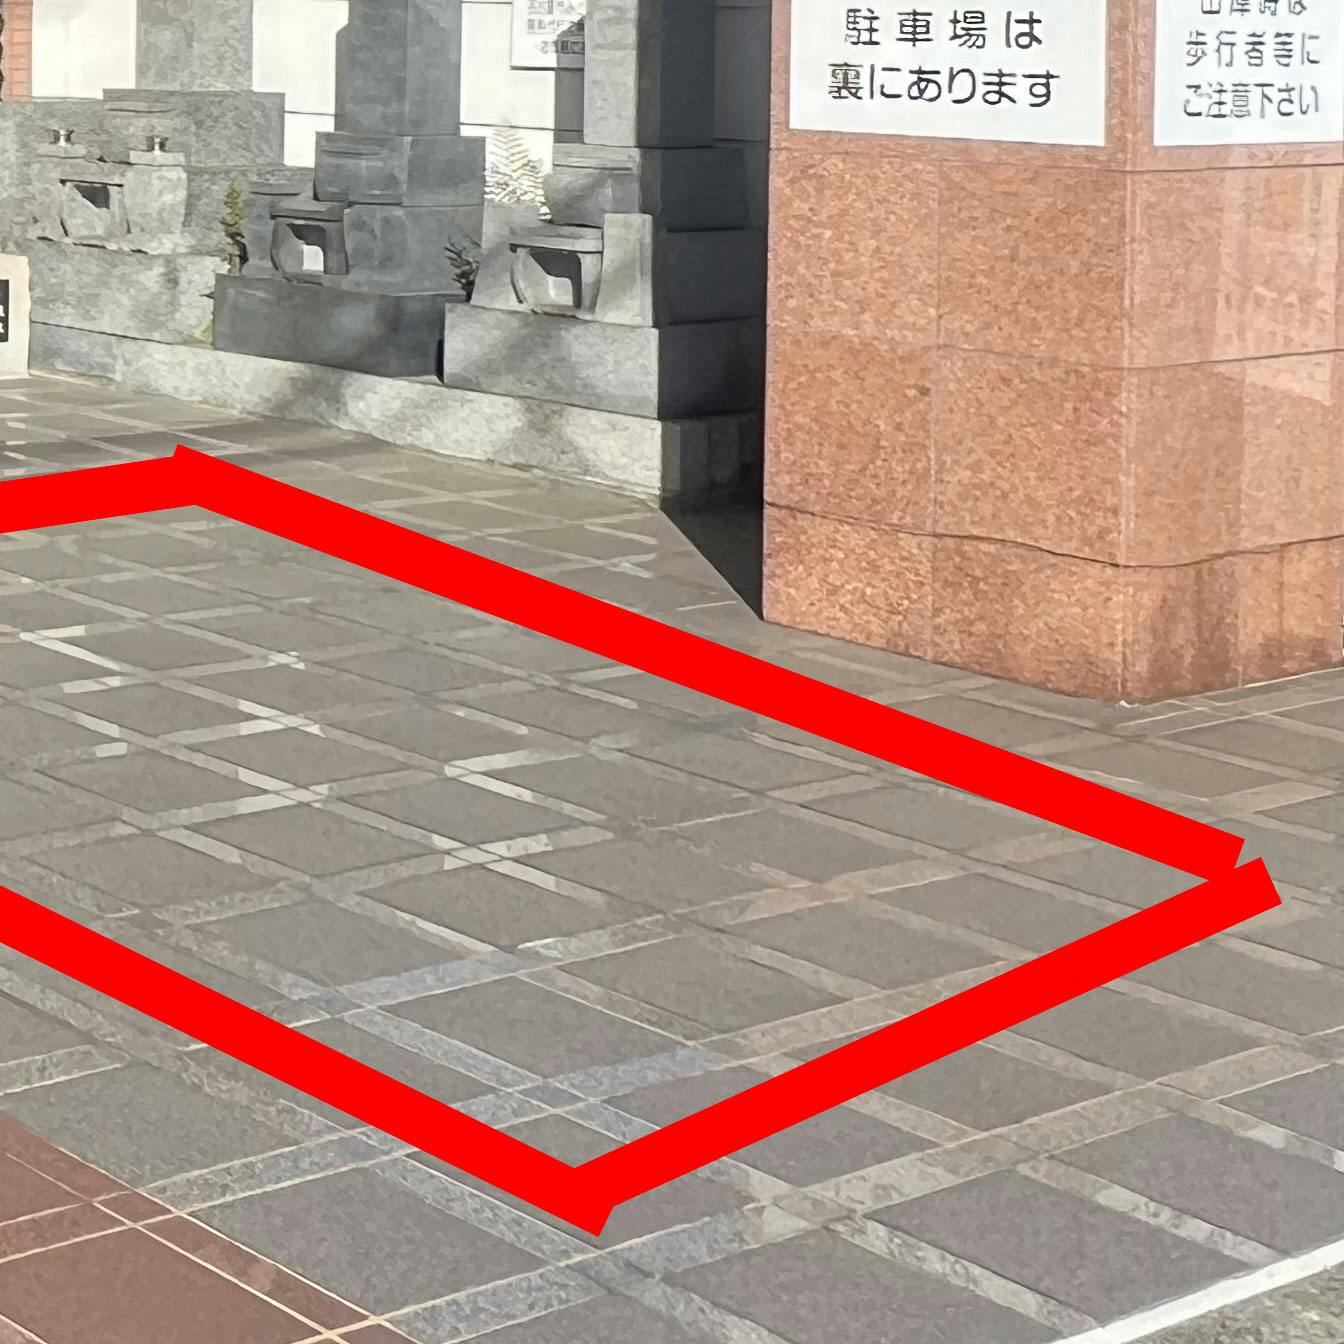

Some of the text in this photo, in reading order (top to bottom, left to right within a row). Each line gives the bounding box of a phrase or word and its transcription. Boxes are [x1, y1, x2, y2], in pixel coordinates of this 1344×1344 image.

[844, 8, 1043, 49] 駐車場は
[1185, 30, 1321, 67] 歩行者等に
[827, 61, 1060, 107] 裏にあります
[1183, 81, 1319, 118] ご注意下さい
